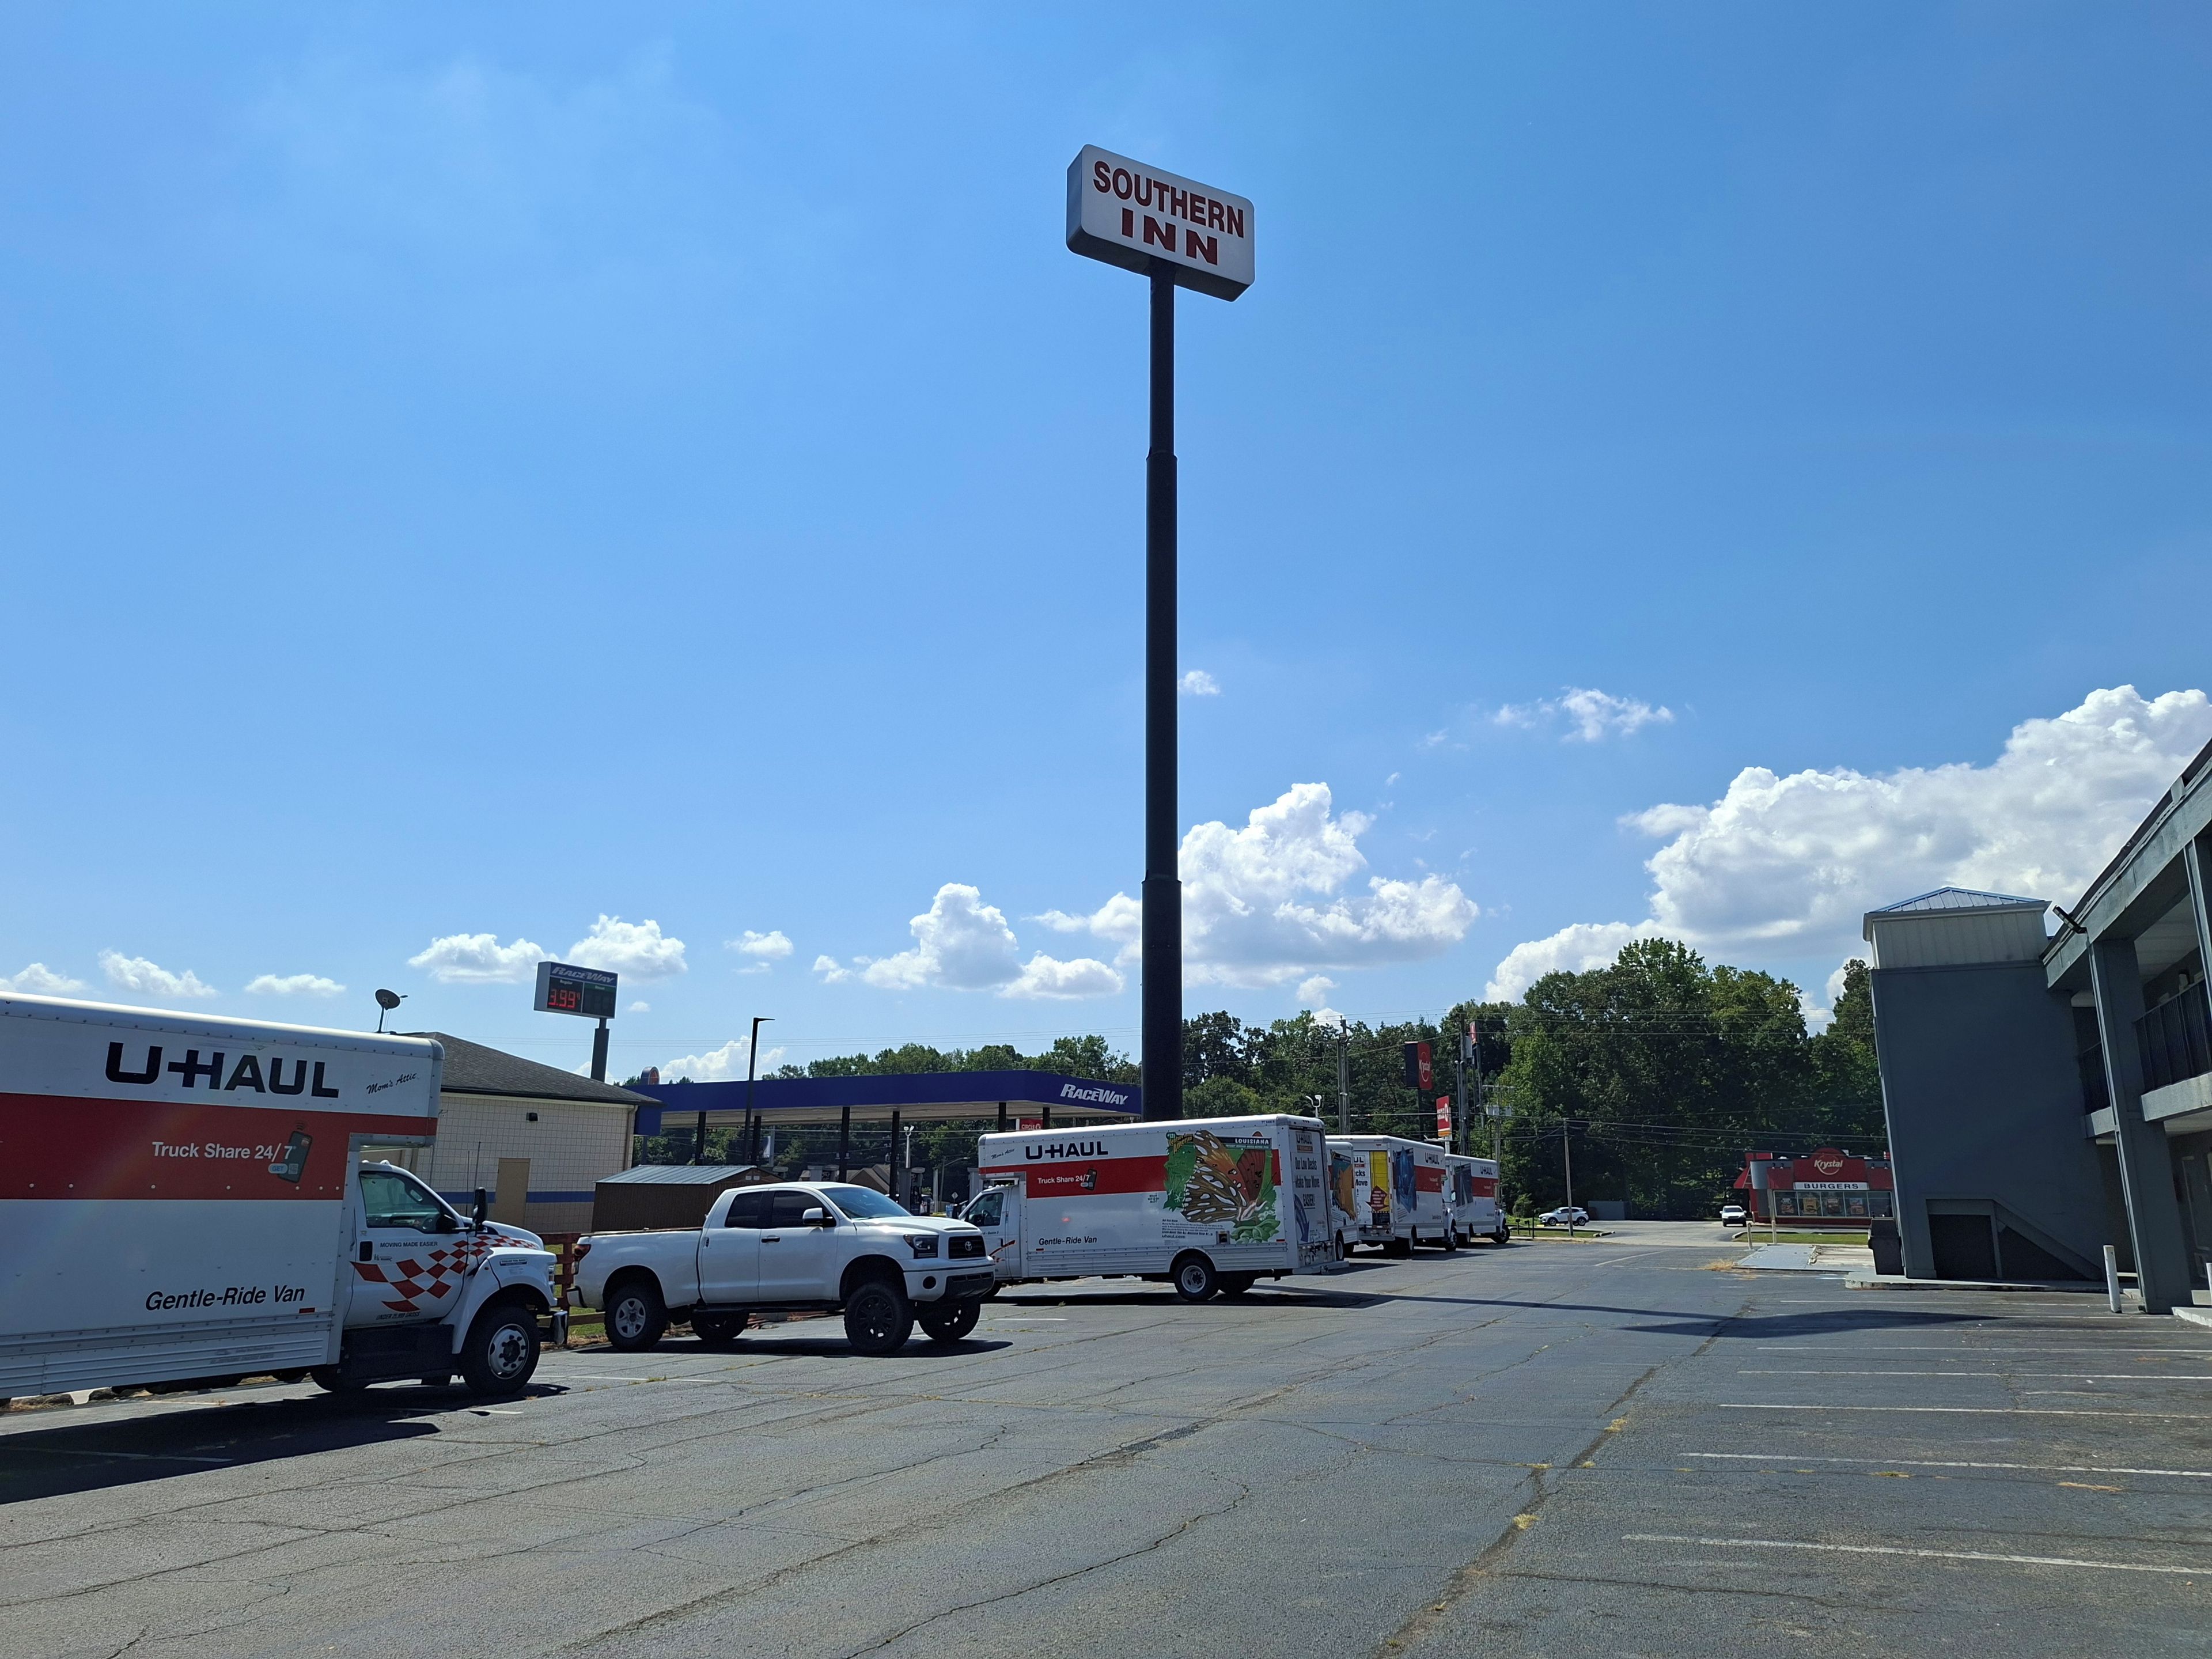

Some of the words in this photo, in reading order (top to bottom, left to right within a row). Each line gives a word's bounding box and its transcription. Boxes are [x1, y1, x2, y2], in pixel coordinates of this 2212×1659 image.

[1093, 161, 1244, 238] SOUTHERN
[1122, 207, 1218, 266] INN
[105, 1041, 339, 1098] U-HAUL
[366, 1080, 393, 1094] Mom's
[396, 1073, 416, 1085] Attic
[152, 1142, 200, 1157] Truck
[204, 1143, 251, 1158] Share
[1025, 1141, 1109, 1160] U-HAUL
[1814, 1159, 1843, 1169] Krystal
[1039, 1237, 1081, 1245] Gentle-Ride
[146, 1286, 266, 1310] Gentle-Ride
[274, 1285, 305, 1302] Van
